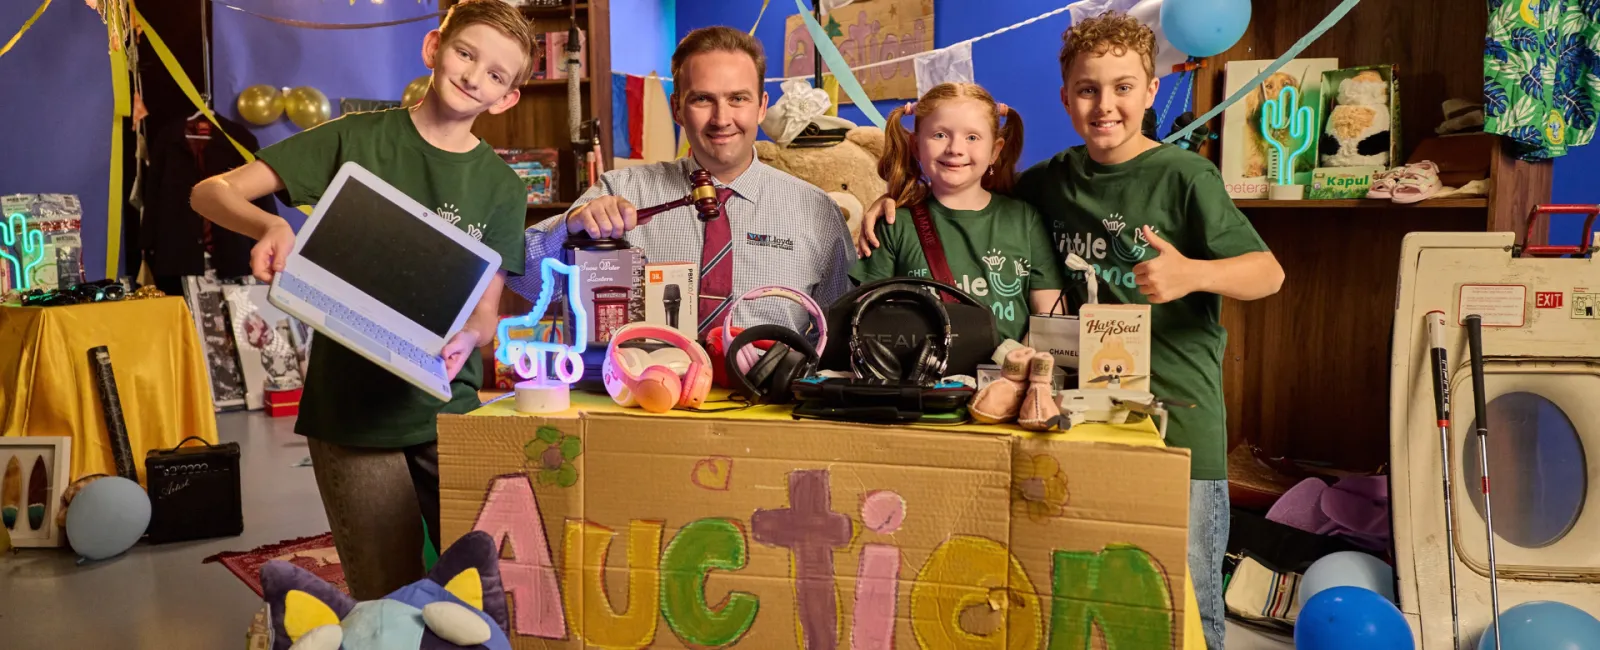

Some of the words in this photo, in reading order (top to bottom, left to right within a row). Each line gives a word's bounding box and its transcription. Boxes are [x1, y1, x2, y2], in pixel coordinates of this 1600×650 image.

[1327, 175, 1369, 188] Kapul
[1052, 231, 1107, 259] Little
[580, 260, 599, 271] Snow
[599, 260, 620, 271] Water
[587, 274, 613, 282] Lantern
[907, 268, 928, 278] CHF
[1536, 293, 1562, 307] EXIT
[1086, 320, 1116, 334] Have
[1112, 321, 1141, 334] Seat
[1049, 348, 1079, 357] CHANEL
[469, 467, 1173, 650] Auction
